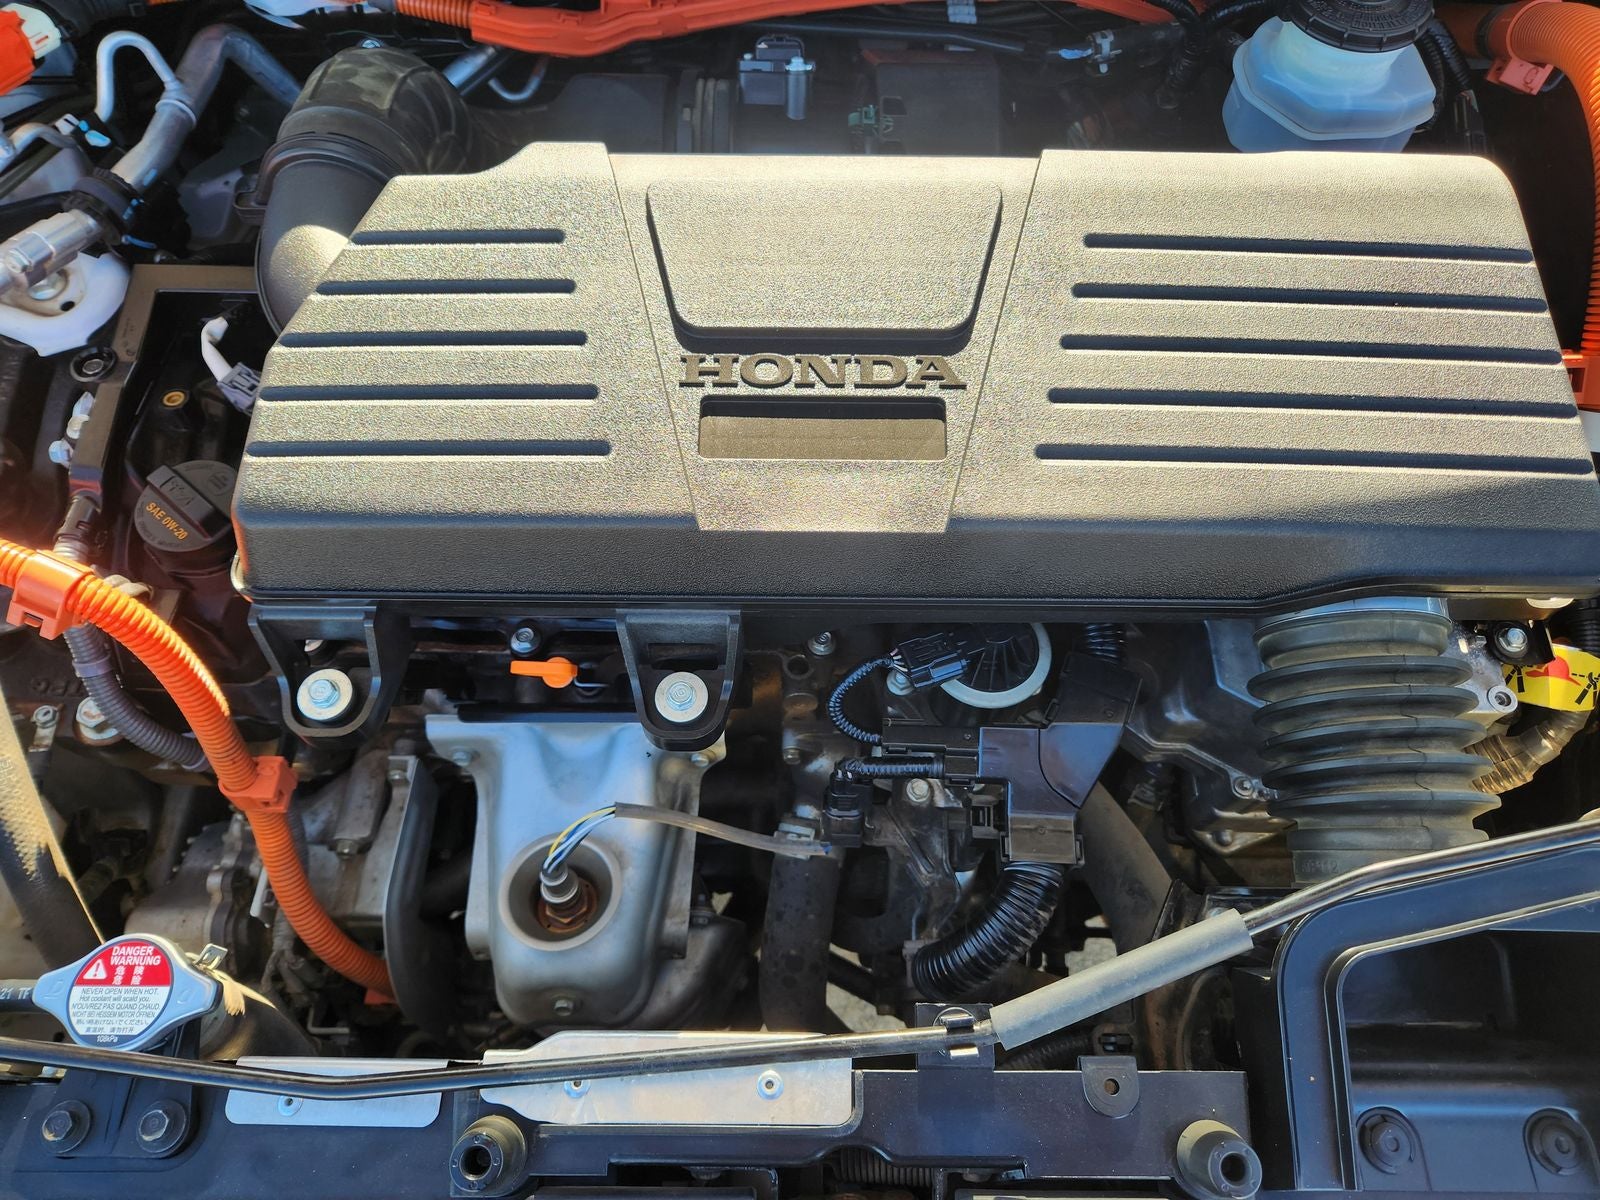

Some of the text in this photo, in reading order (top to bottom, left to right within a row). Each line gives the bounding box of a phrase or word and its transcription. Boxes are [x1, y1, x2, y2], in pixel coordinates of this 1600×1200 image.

[679, 352, 967, 389] HONDA
[146, 502, 166, 520] SAE
[162, 516, 189, 541] 0W-20
[112, 945, 154, 956] DANGER
[110, 955, 161, 966] WARNUNG
[96, 1035, 118, 1043] 108kPa
